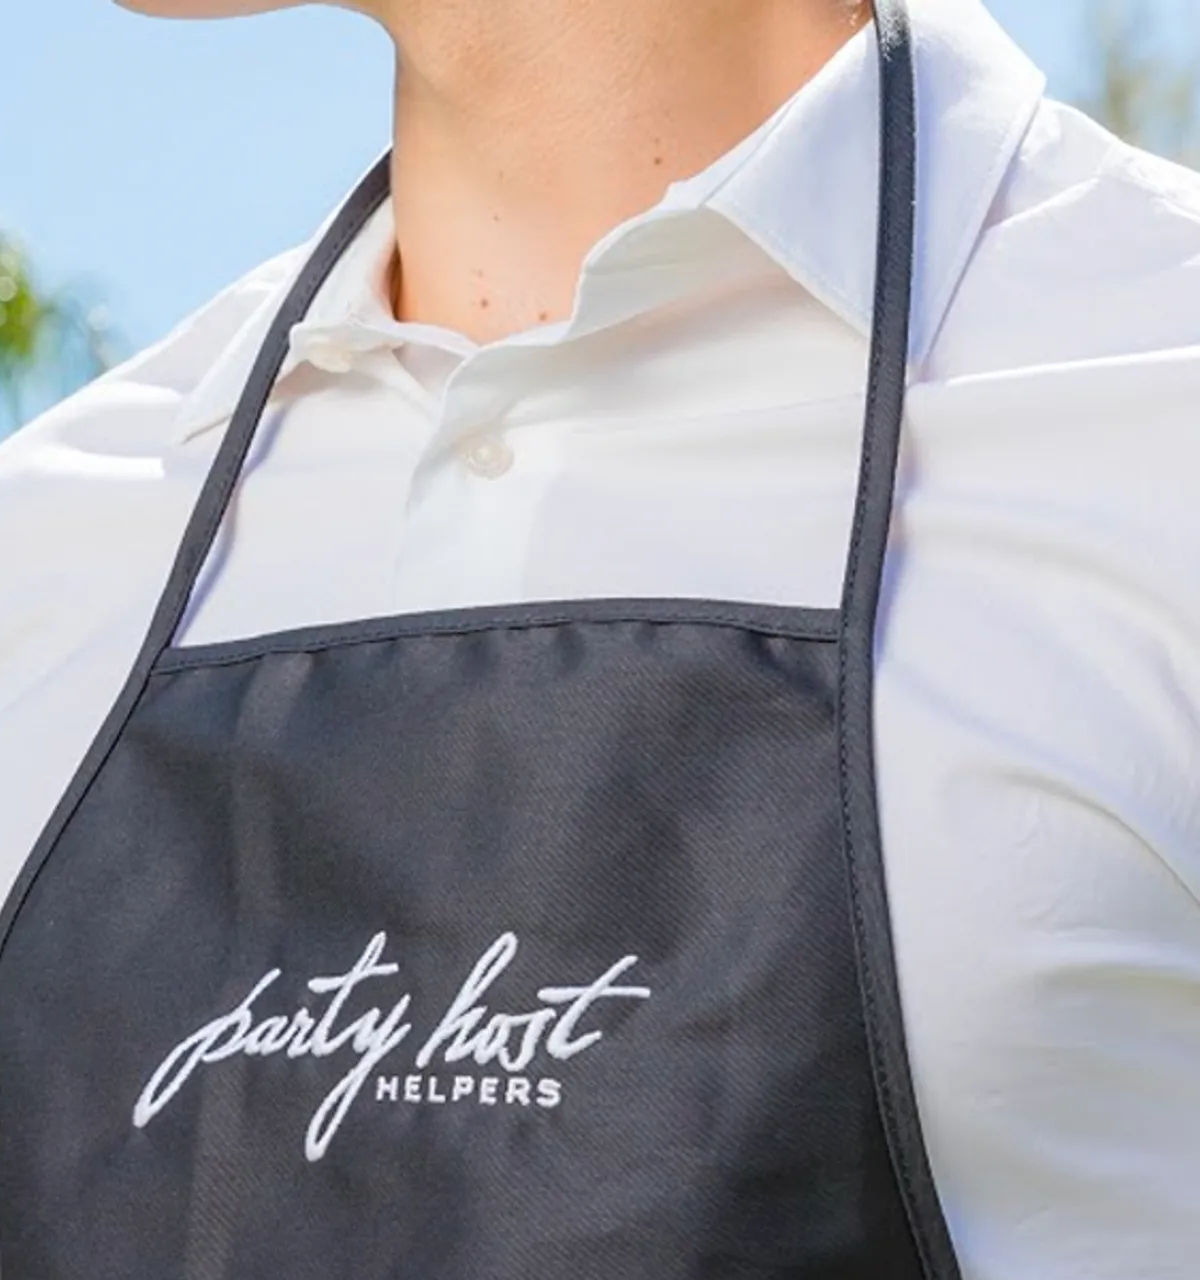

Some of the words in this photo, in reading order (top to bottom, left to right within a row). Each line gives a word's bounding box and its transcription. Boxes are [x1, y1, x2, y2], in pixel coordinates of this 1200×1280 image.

[132, 931, 411, 1162] party
[415, 931, 651, 1070] host
[376, 1074, 563, 1108] HELPERS
